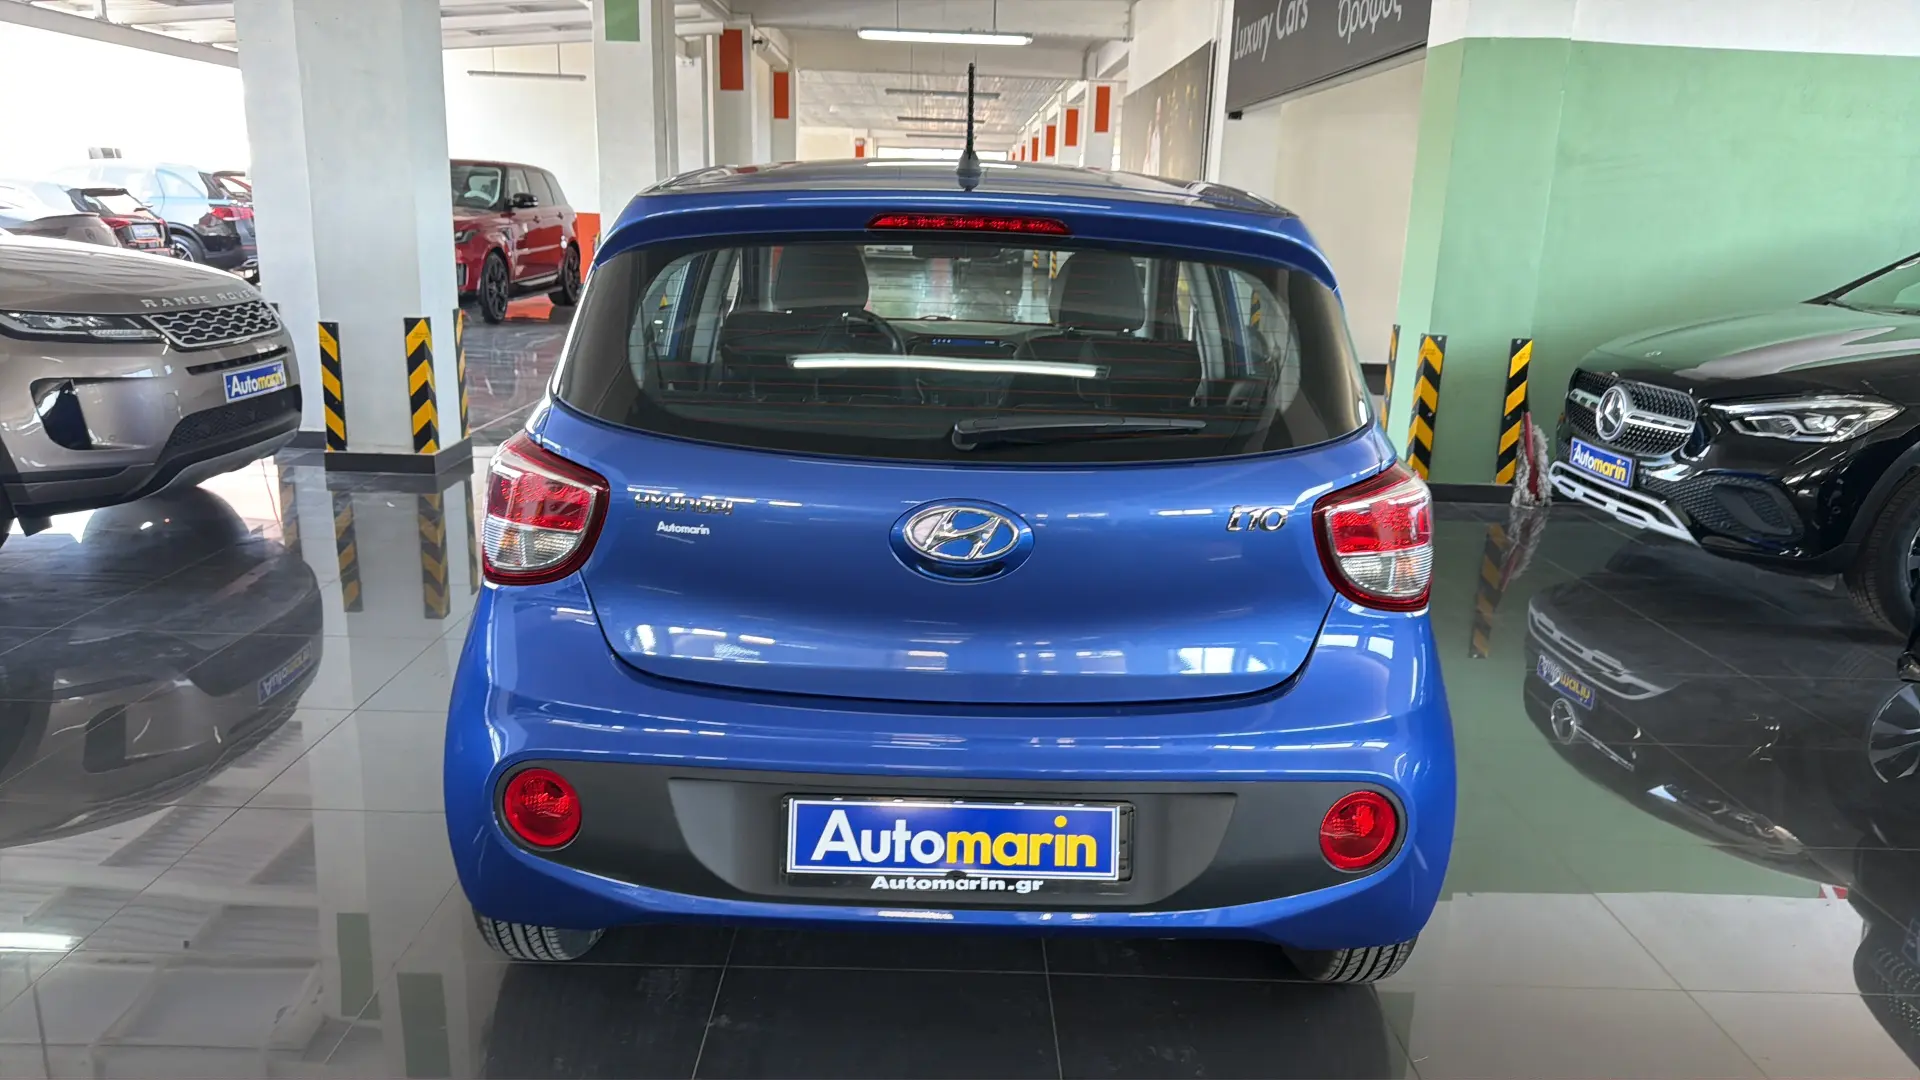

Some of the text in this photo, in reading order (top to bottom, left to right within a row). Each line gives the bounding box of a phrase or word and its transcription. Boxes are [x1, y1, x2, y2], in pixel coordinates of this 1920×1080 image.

[1234, 0, 1308, 62] Luxury Cars
[141, 295, 211, 308] RANGE
[1573, 443, 1627, 481] Automarin
[657, 520, 711, 535] Automarin
[810, 809, 1097, 868] Automarin
[870, 875, 1044, 894] Automarin.gr
